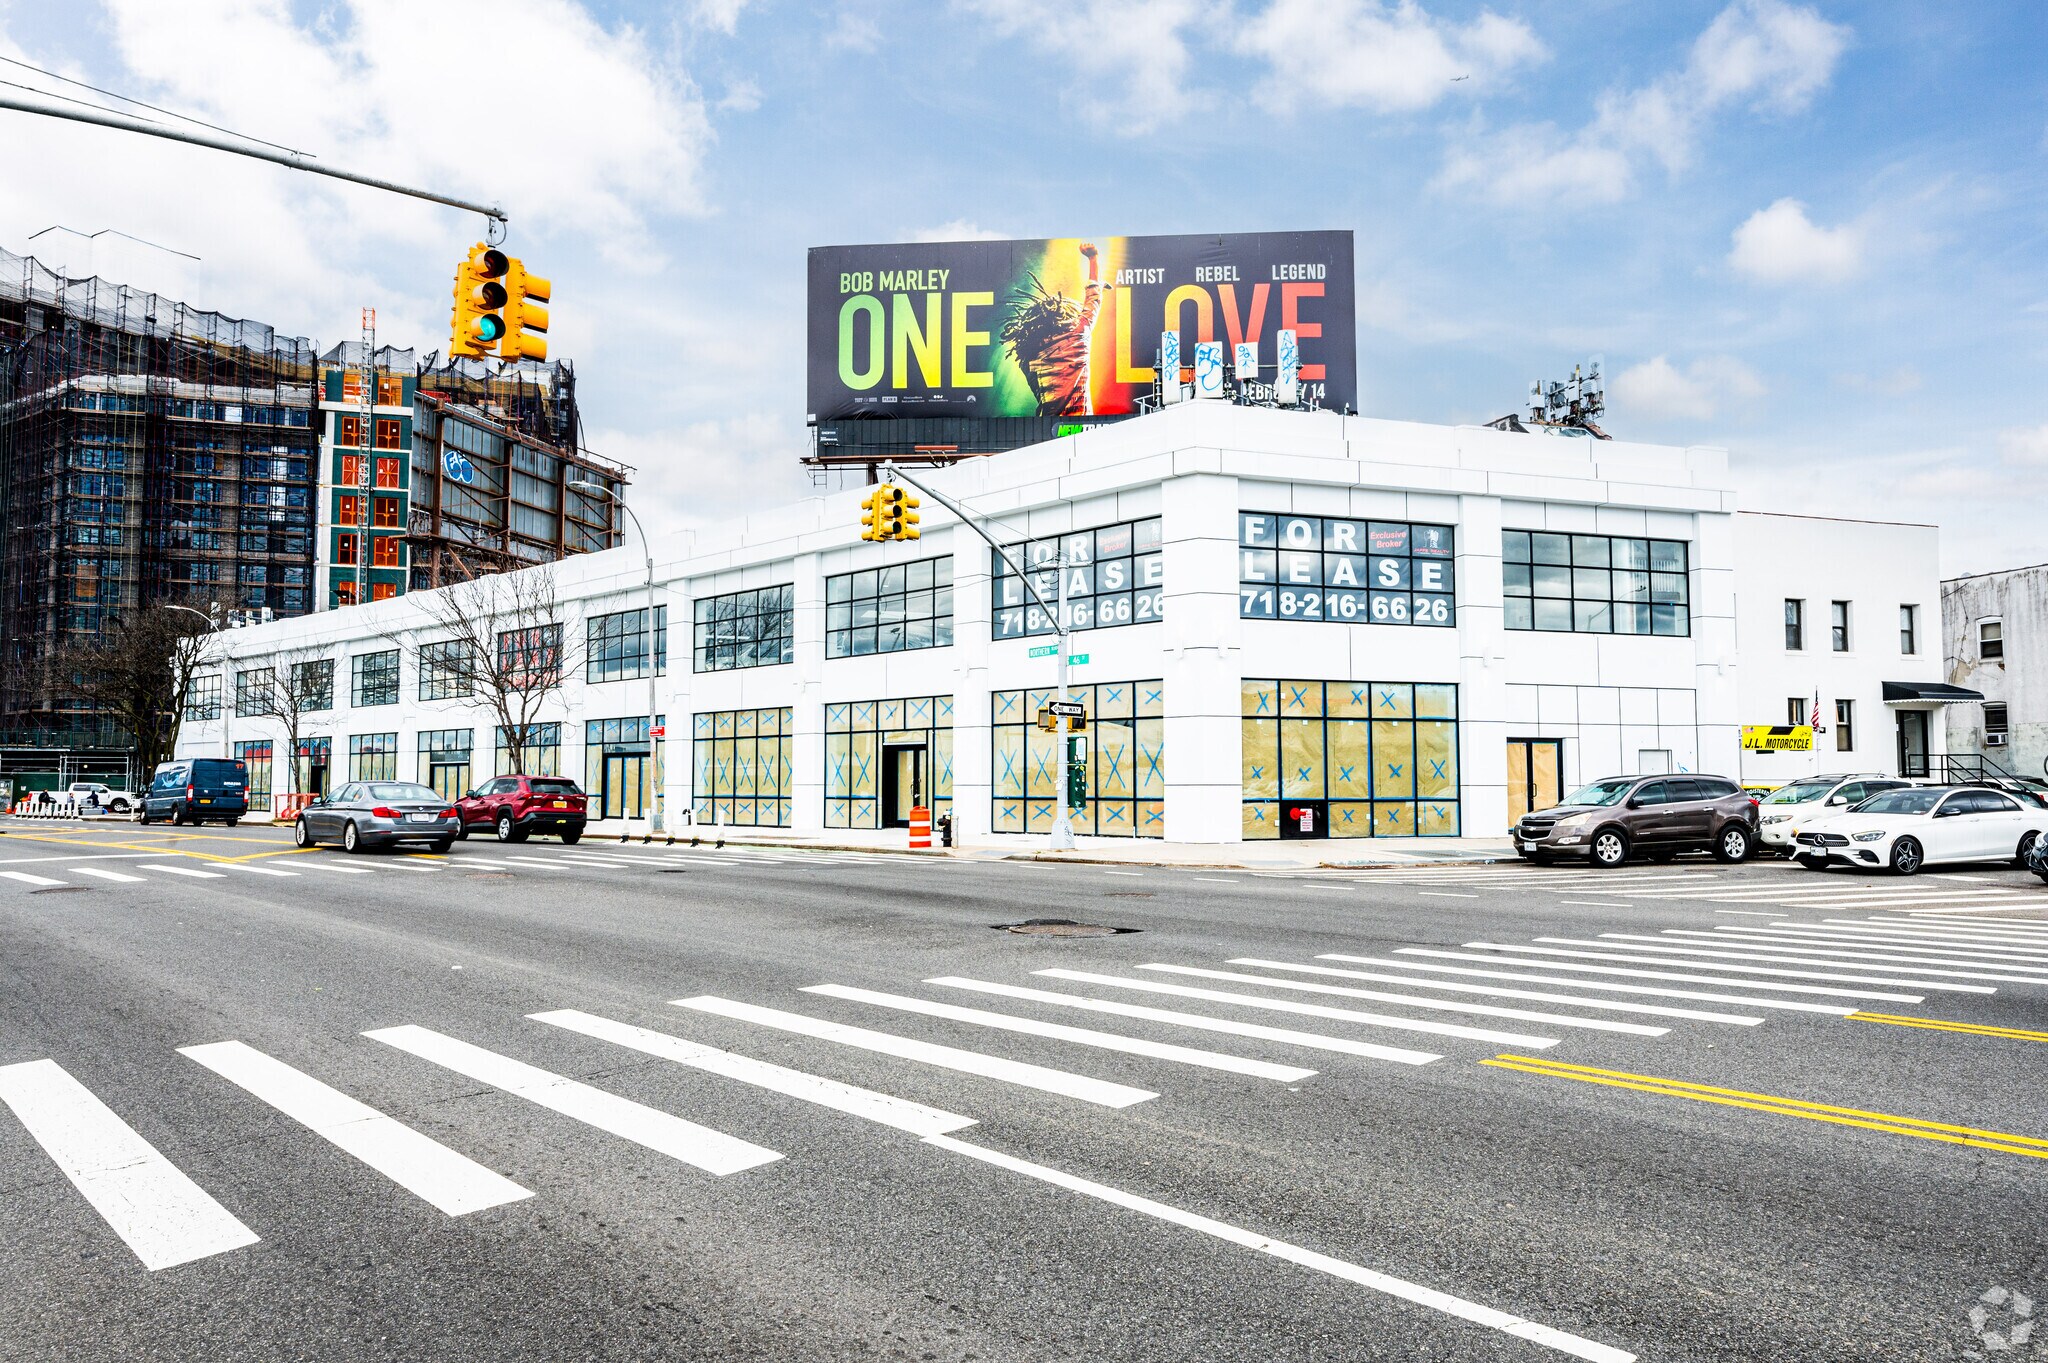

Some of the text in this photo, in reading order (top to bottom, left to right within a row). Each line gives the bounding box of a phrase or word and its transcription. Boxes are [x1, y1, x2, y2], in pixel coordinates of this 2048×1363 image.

[1115, 268, 1165, 284] ARTIST
[1195, 266, 1240, 283] REBEL
[1271, 264, 1326, 280] LEGEND
[840, 269, 950, 293] BOB MARLEY
[839, 292, 994, 390] ONE
[1115, 282, 1325, 383] LOVE
[1311, 383, 1326, 399] 14
[1246, 517, 1357, 550] FOR
[1370, 531, 1406, 540] Exclusive
[1376, 540, 1402, 548] Broker
[1244, 552, 1443, 590] LEASE
[1072, 655, 1080, 664] 46
[1745, 738, 1809, 749] J.L. MOTORCYCLE
